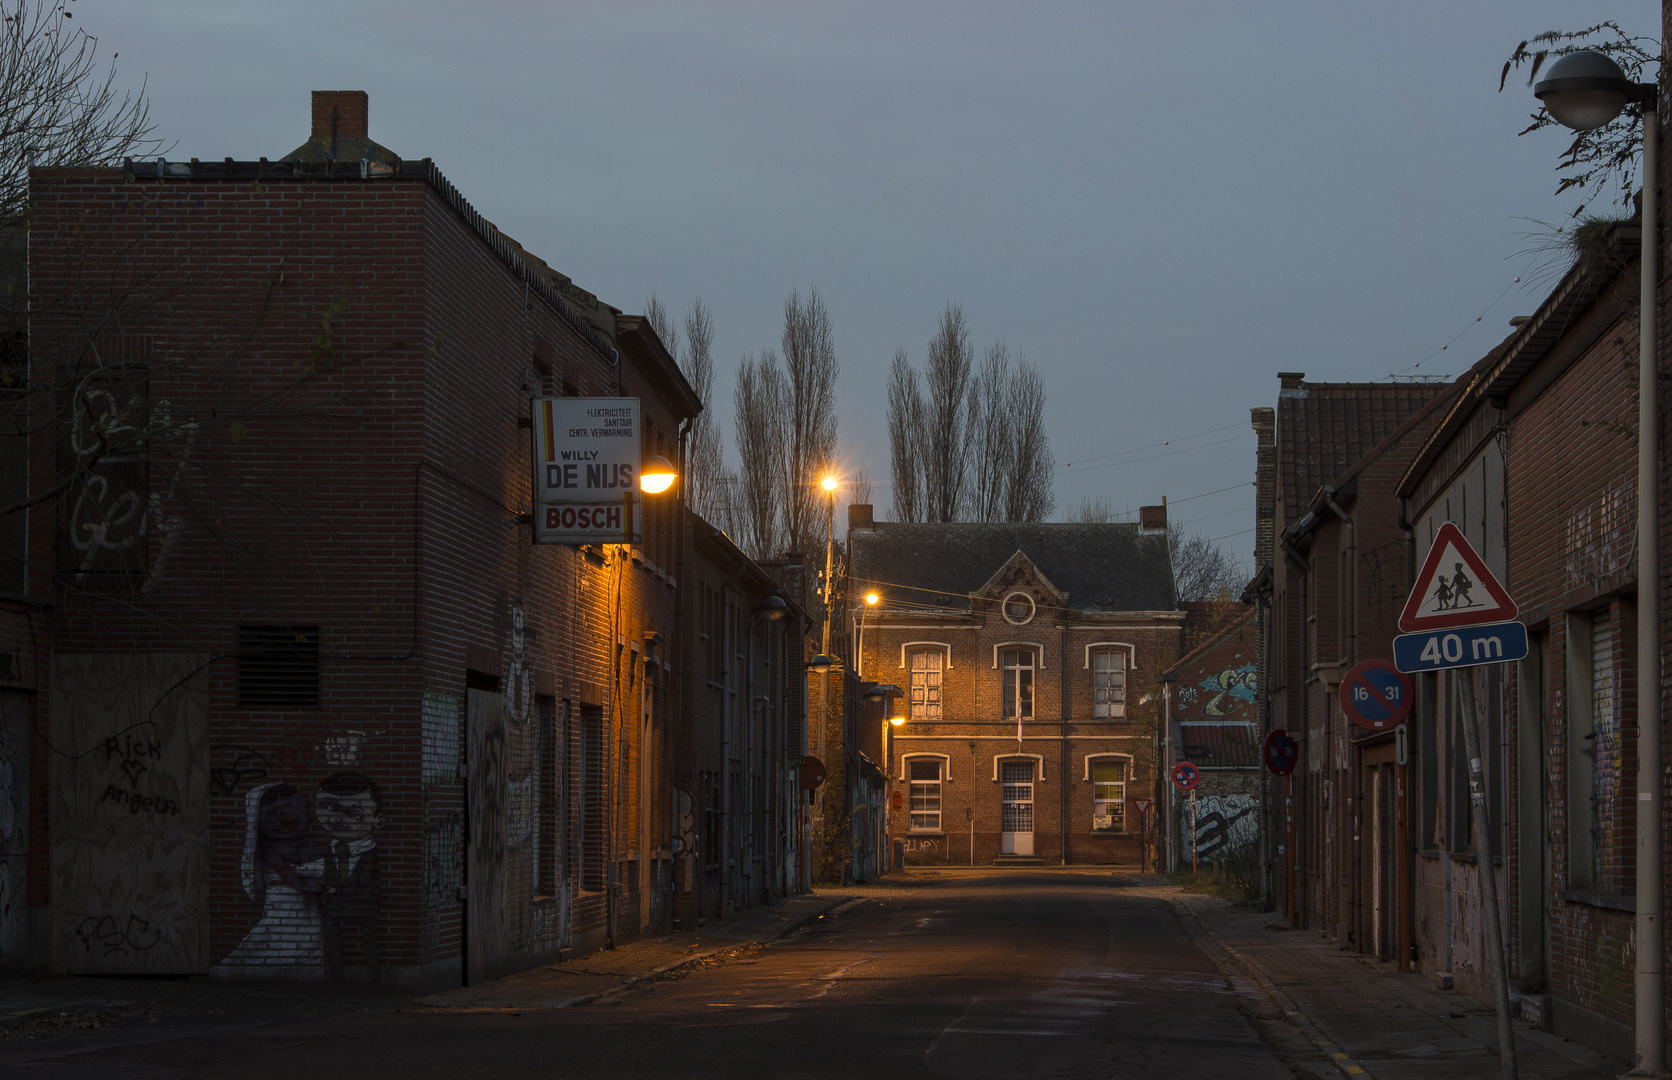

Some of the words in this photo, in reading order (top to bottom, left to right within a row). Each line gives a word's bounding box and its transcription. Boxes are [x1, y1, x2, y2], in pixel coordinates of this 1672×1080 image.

[604, 418, 632, 427] SANITAIR
[568, 428, 589, 438] CENTR.
[591, 428, 633, 438] VERWARMING
[560, 450, 599, 460] WILLY
[546, 464, 578, 489] DE
[586, 463, 633, 489] NIJS
[546, 507, 620, 529] BOSCH
[1420, 633, 1463, 665] 40
[1471, 635, 1503, 660] m
[1353, 686, 1369, 701] 16
[1384, 686, 1400, 701] 31
[1270, 747, 1279, 758] 16
[1284, 746, 1293, 757] 31
